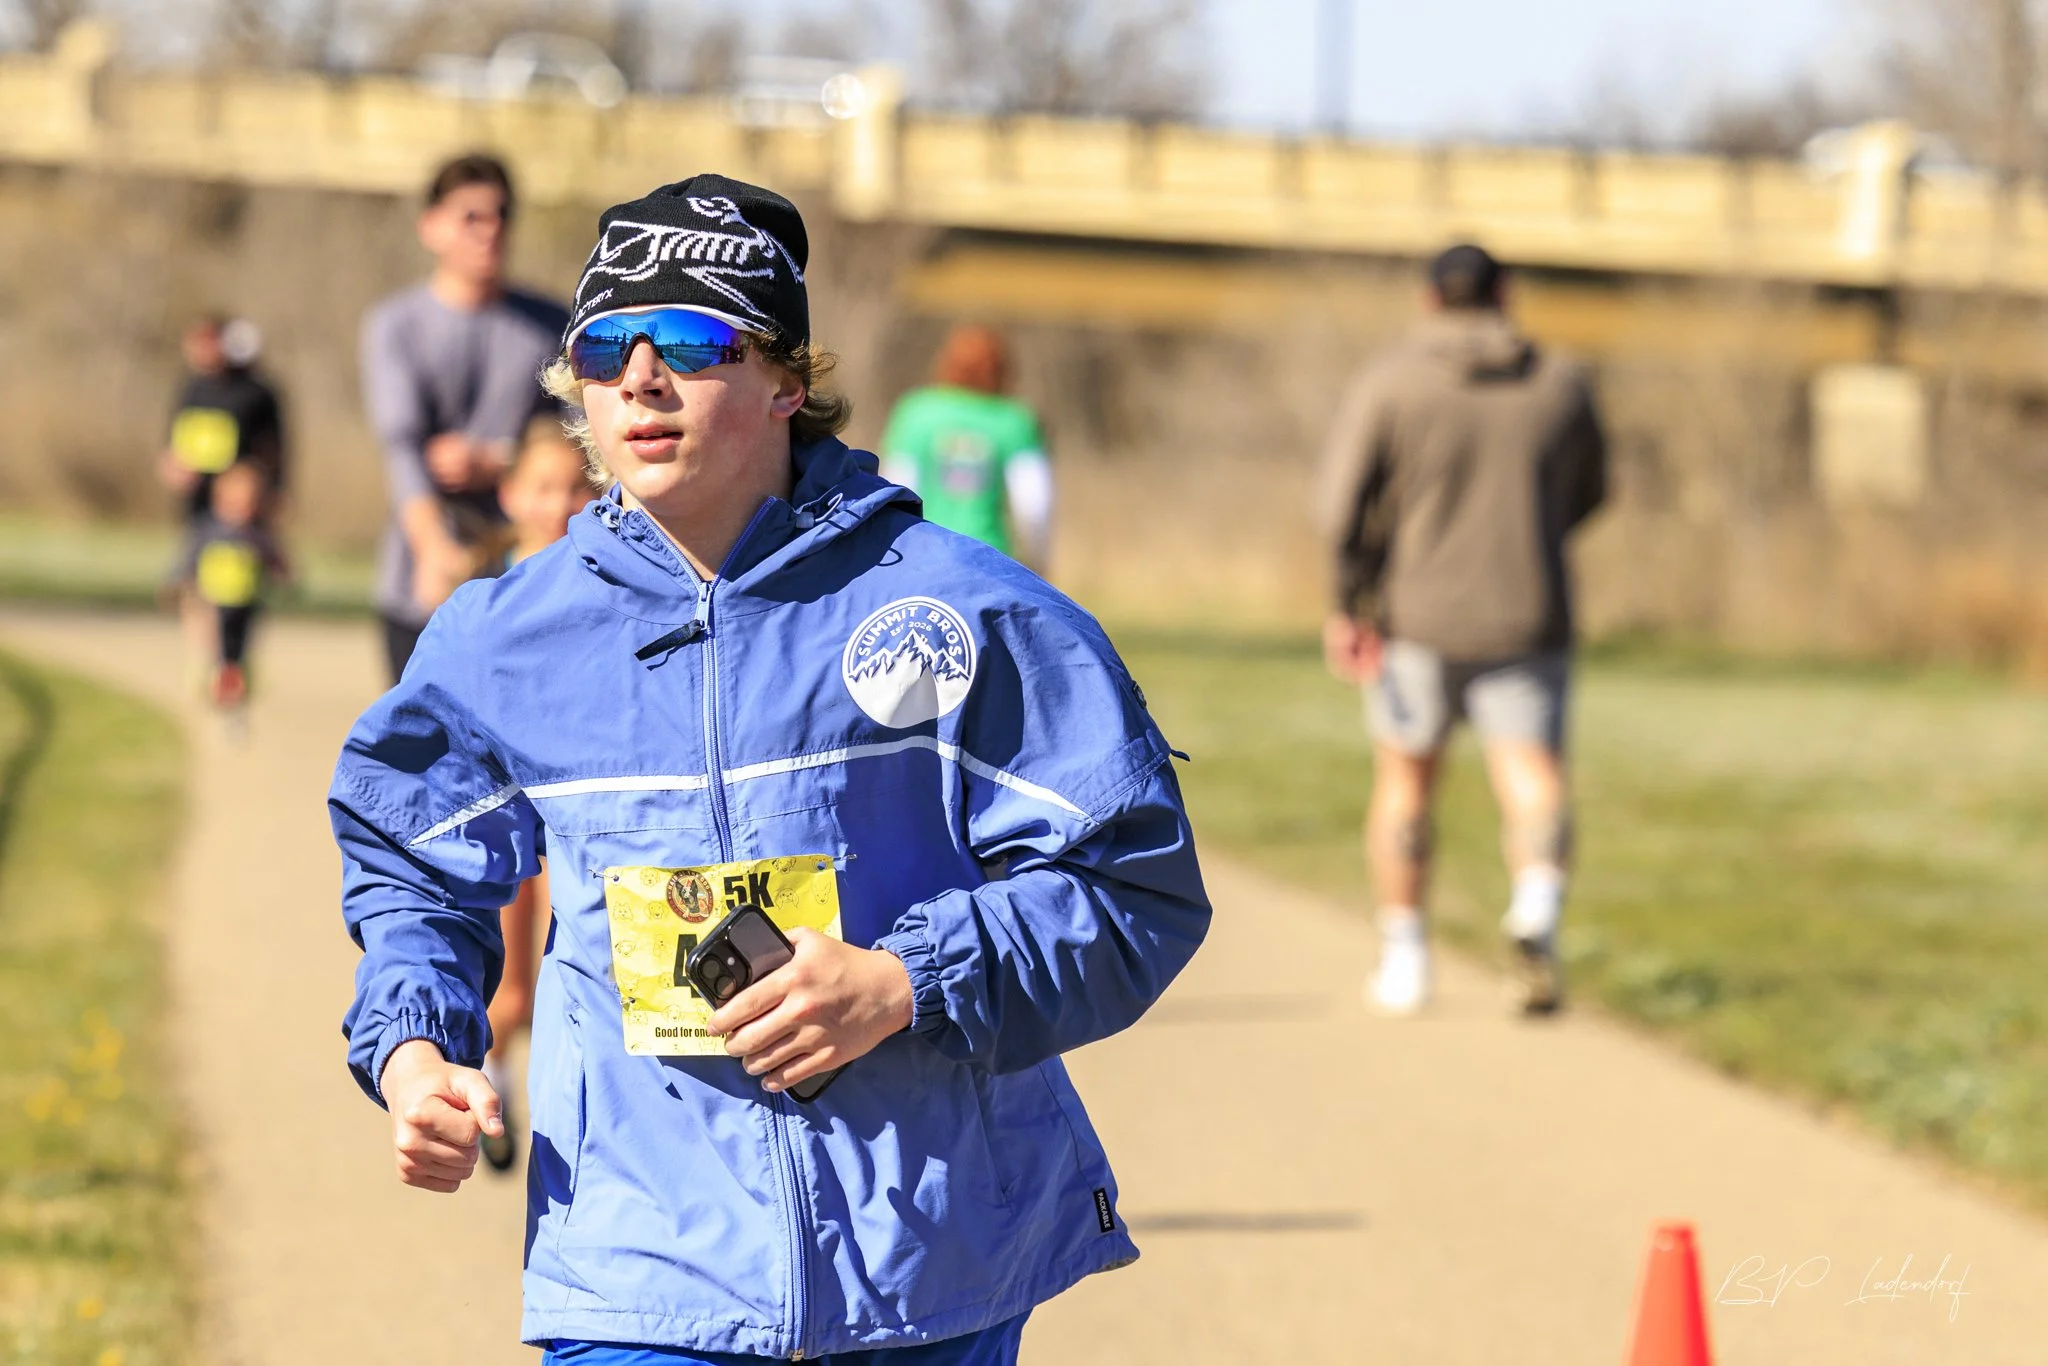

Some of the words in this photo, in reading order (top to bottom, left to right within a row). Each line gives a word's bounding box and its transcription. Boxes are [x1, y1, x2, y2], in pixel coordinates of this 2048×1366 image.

[858, 606, 918, 657] SUMMIT
[926, 610, 963, 657] BROS
[890, 623, 905, 637] EST
[907, 621, 933, 632] 2026
[723, 871, 775, 909] 5K
[655, 1026, 679, 1038] Good
[680, 1026, 693, 1038] for
[1097, 1192, 1111, 1229] PACKABLE
